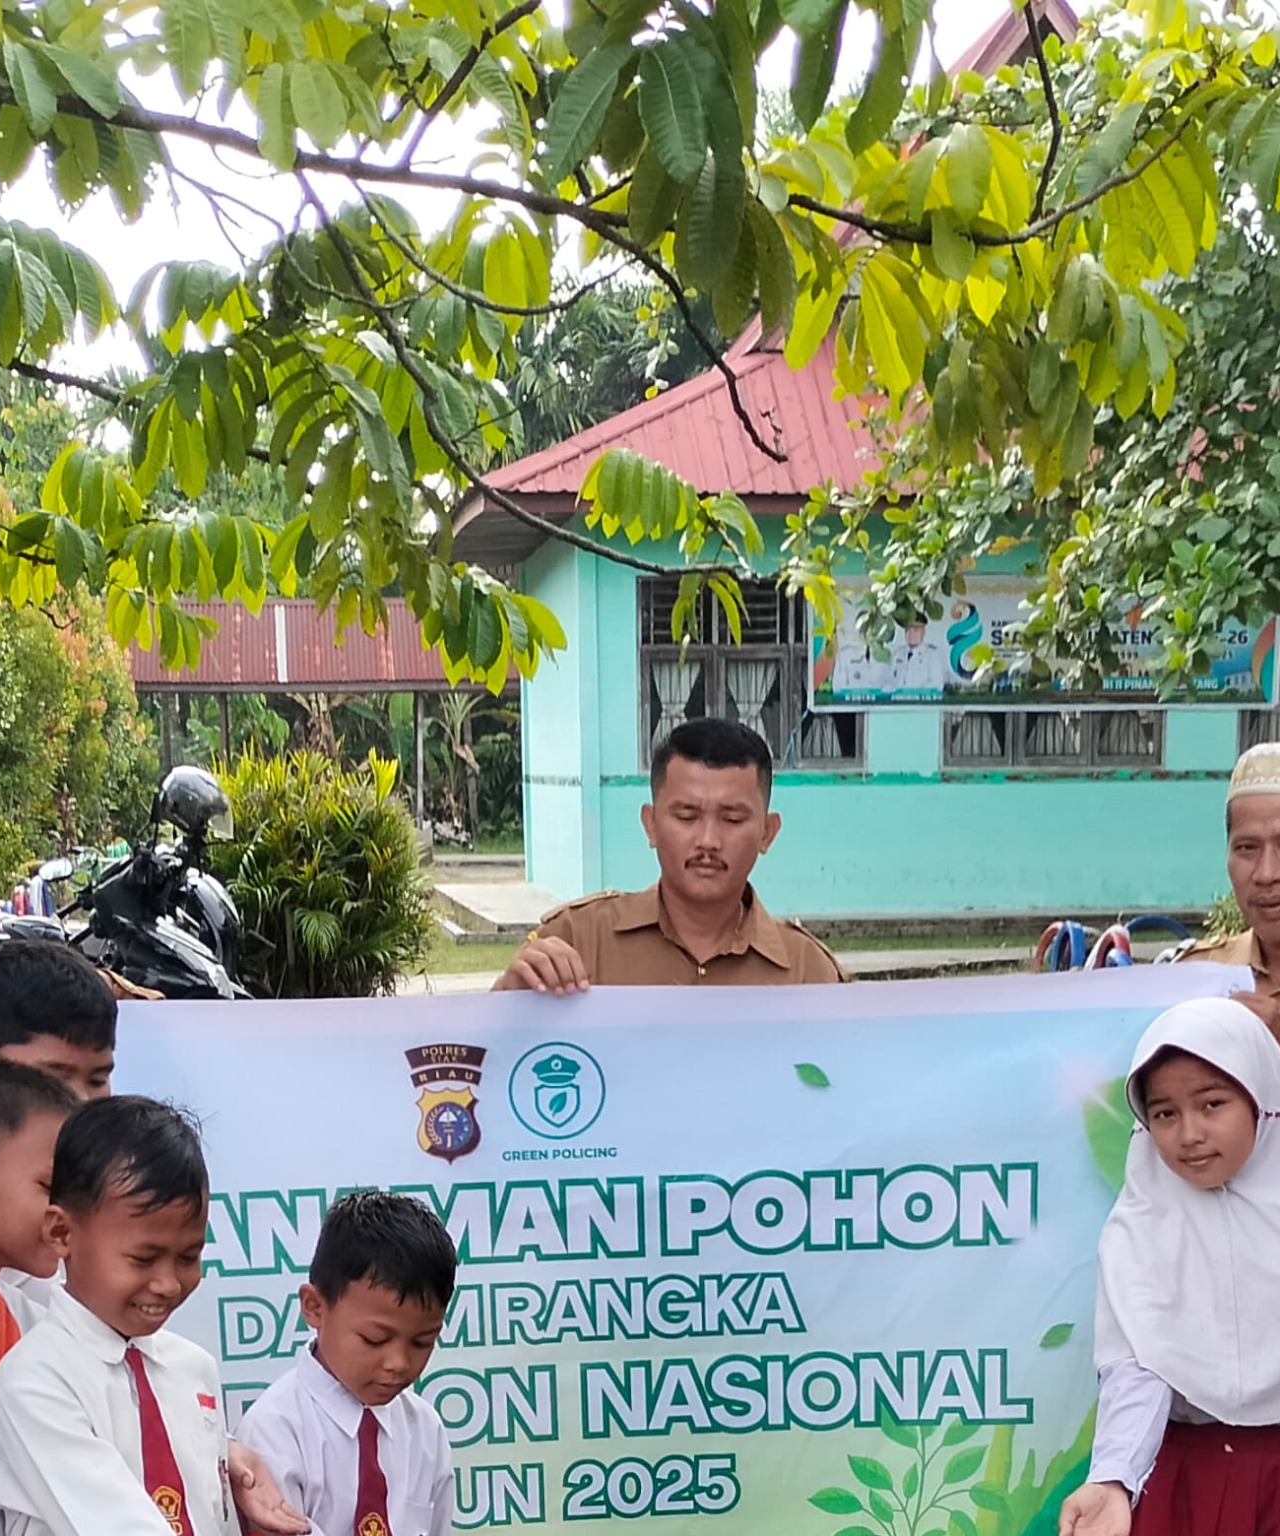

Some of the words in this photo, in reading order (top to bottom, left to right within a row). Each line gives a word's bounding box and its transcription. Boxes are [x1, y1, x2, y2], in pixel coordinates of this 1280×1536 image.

[418, 1069, 474, 1083] RIAU
[421, 1045, 468, 1057] POLRES
[502, 1149, 548, 1162] GREEN
[552, 1147, 618, 1160] POLICING
[659, 1162, 1038, 1257] POHON
[489, 1272, 807, 1347] RANGKA
[580, 1348, 1034, 1440] NASIONAL
[562, 1453, 742, 1521] 2025
